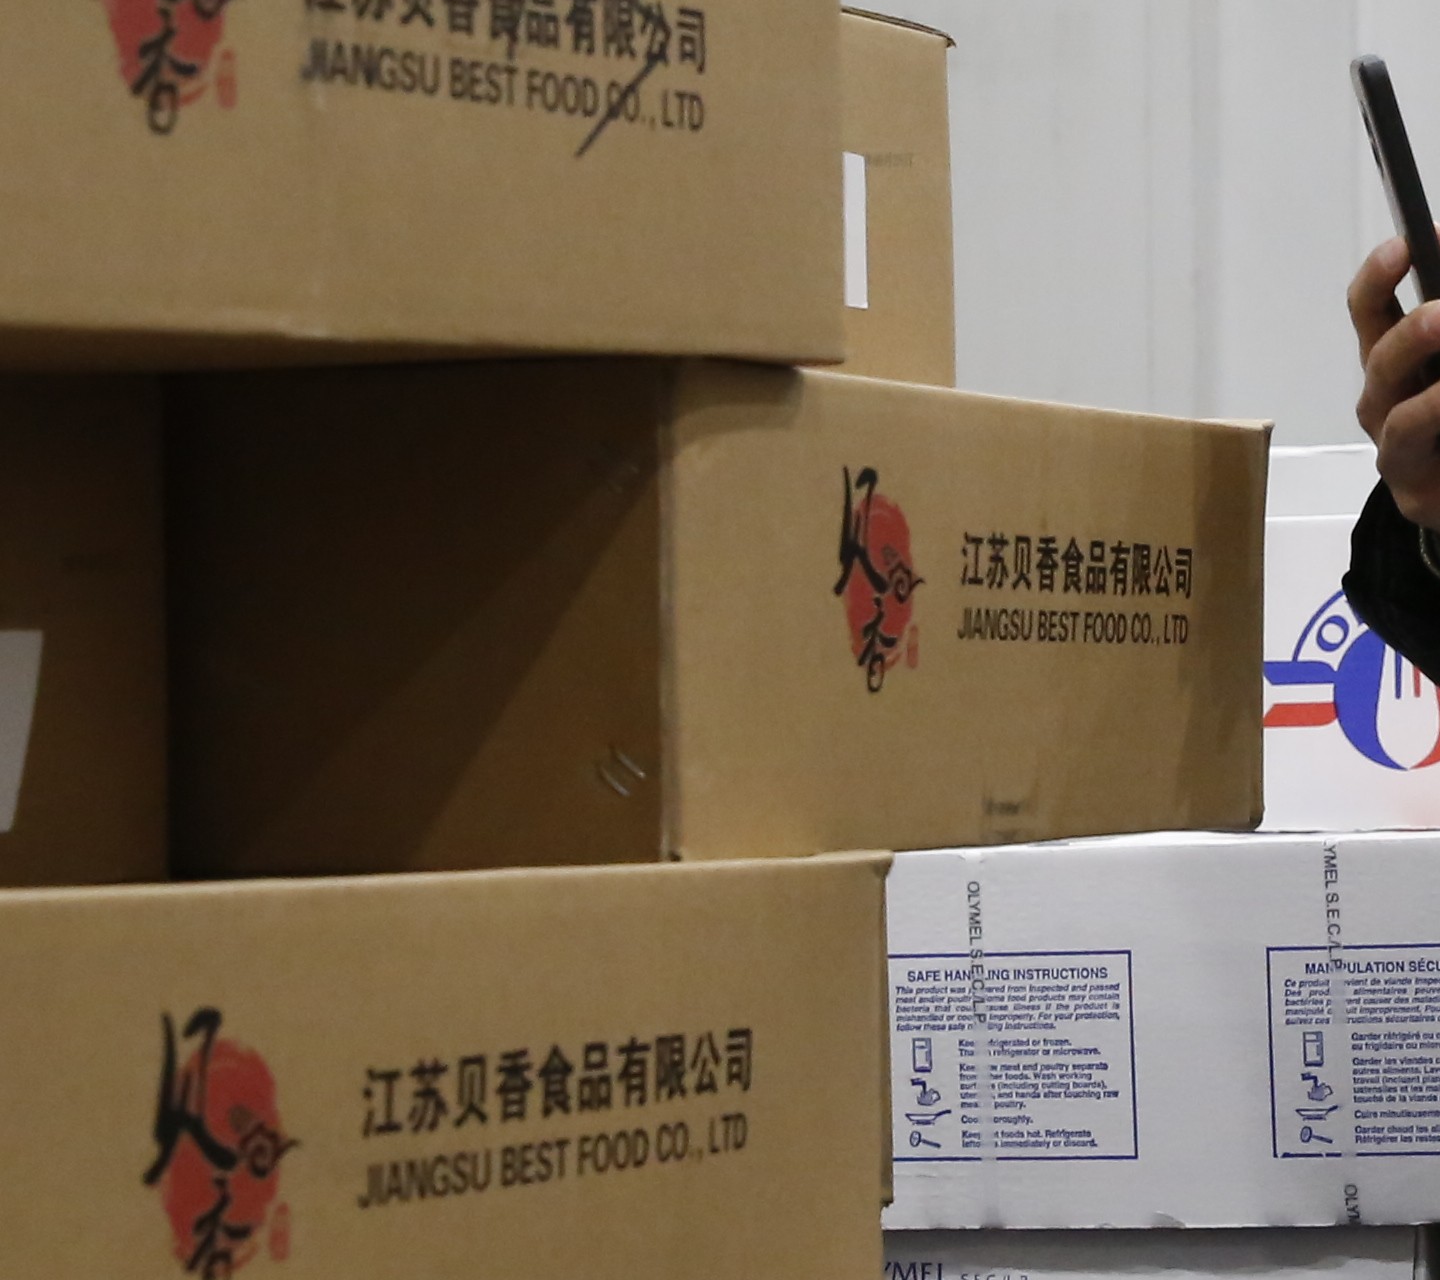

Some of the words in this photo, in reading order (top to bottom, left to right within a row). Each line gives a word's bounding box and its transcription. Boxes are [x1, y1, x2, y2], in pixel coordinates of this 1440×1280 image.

[300, 35, 442, 100] JIANGSU
[448, 56, 518, 106] BEST
[526, 68, 600, 119] FOOD
[661, 88, 706, 132] LTD
[960, 531, 1193, 600] 江苏贝香食品有限公司
[957, 607, 1032, 642] JIANGSU
[1037, 609, 1080, 644] BEST
[1083, 612, 1127, 645] FOOD
[1163, 613, 1189, 646] LTD
[1323, 839, 1339, 889] YMEL
[967, 880, 983, 946] OLYMEL
[907, 970, 940, 982] SAFE
[944, 968, 1010, 981] HANING
[1013, 967, 1108, 980] INSTRUCTIONS
[362, 1026, 754, 1140] 江苏贝香食品有限公司
[356, 1149, 492, 1210] JIANGSU
[500, 1140, 568, 1188] BEST
[577, 1127, 648, 1177] FOOD
[709, 1111, 748, 1157] LTD
